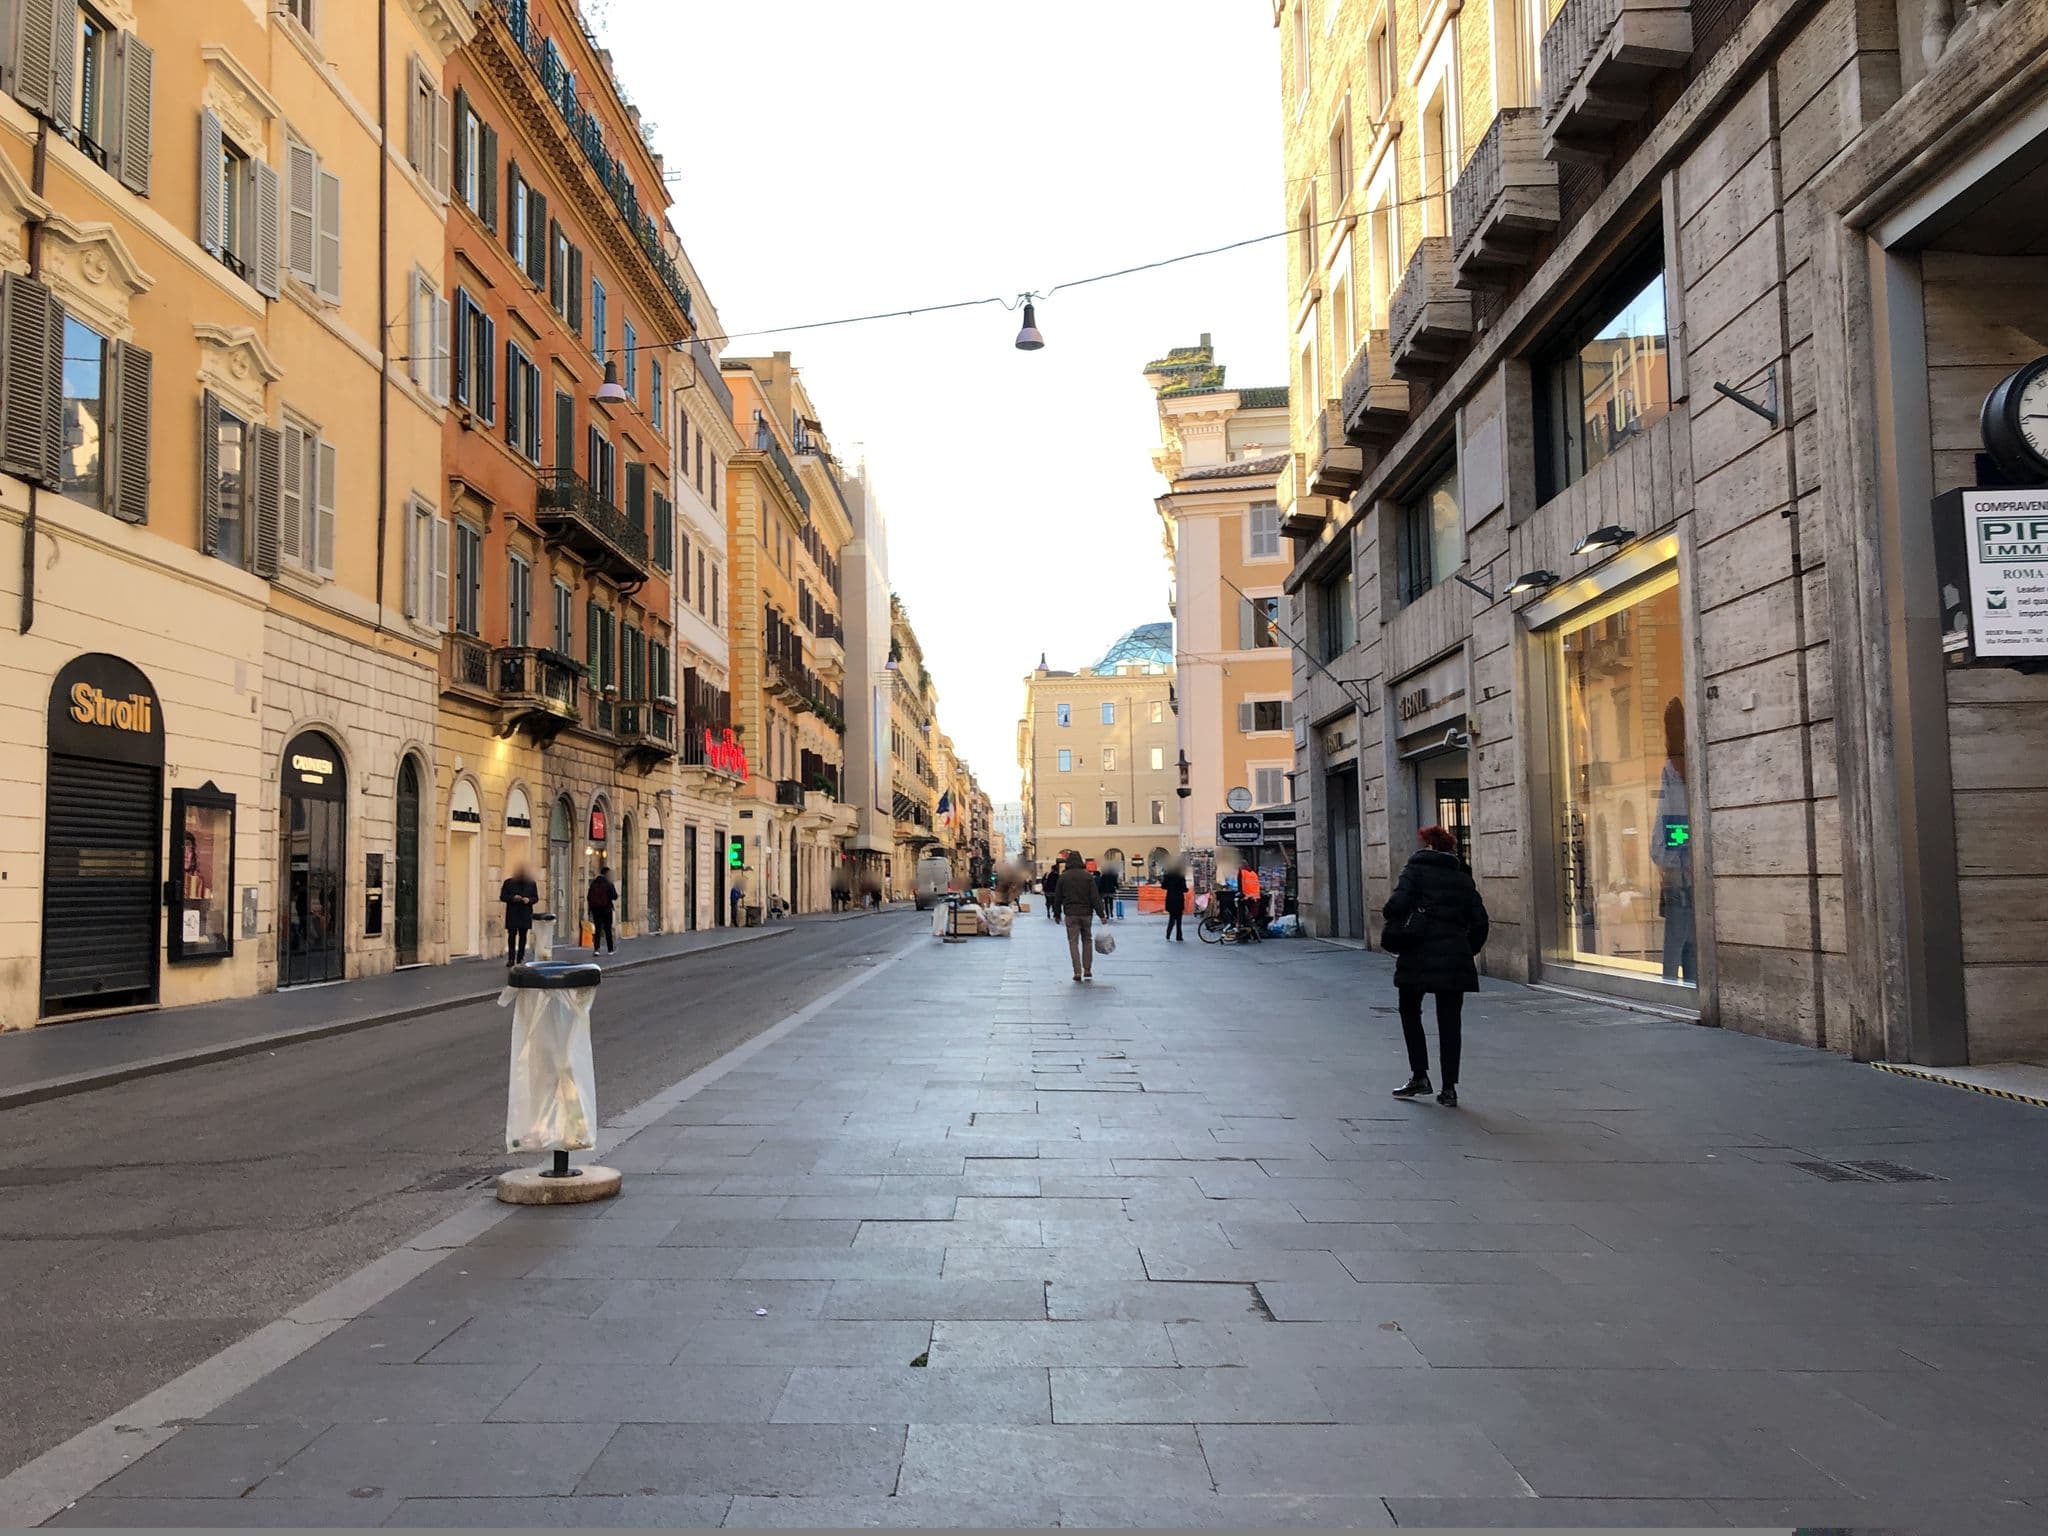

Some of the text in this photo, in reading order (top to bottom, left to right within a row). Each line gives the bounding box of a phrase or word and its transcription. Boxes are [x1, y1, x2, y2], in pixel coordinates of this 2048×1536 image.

[2003, 569, 2044, 579] ROMA
[70, 682, 151, 734] Stroili
[1405, 688, 1427, 717] BNL
